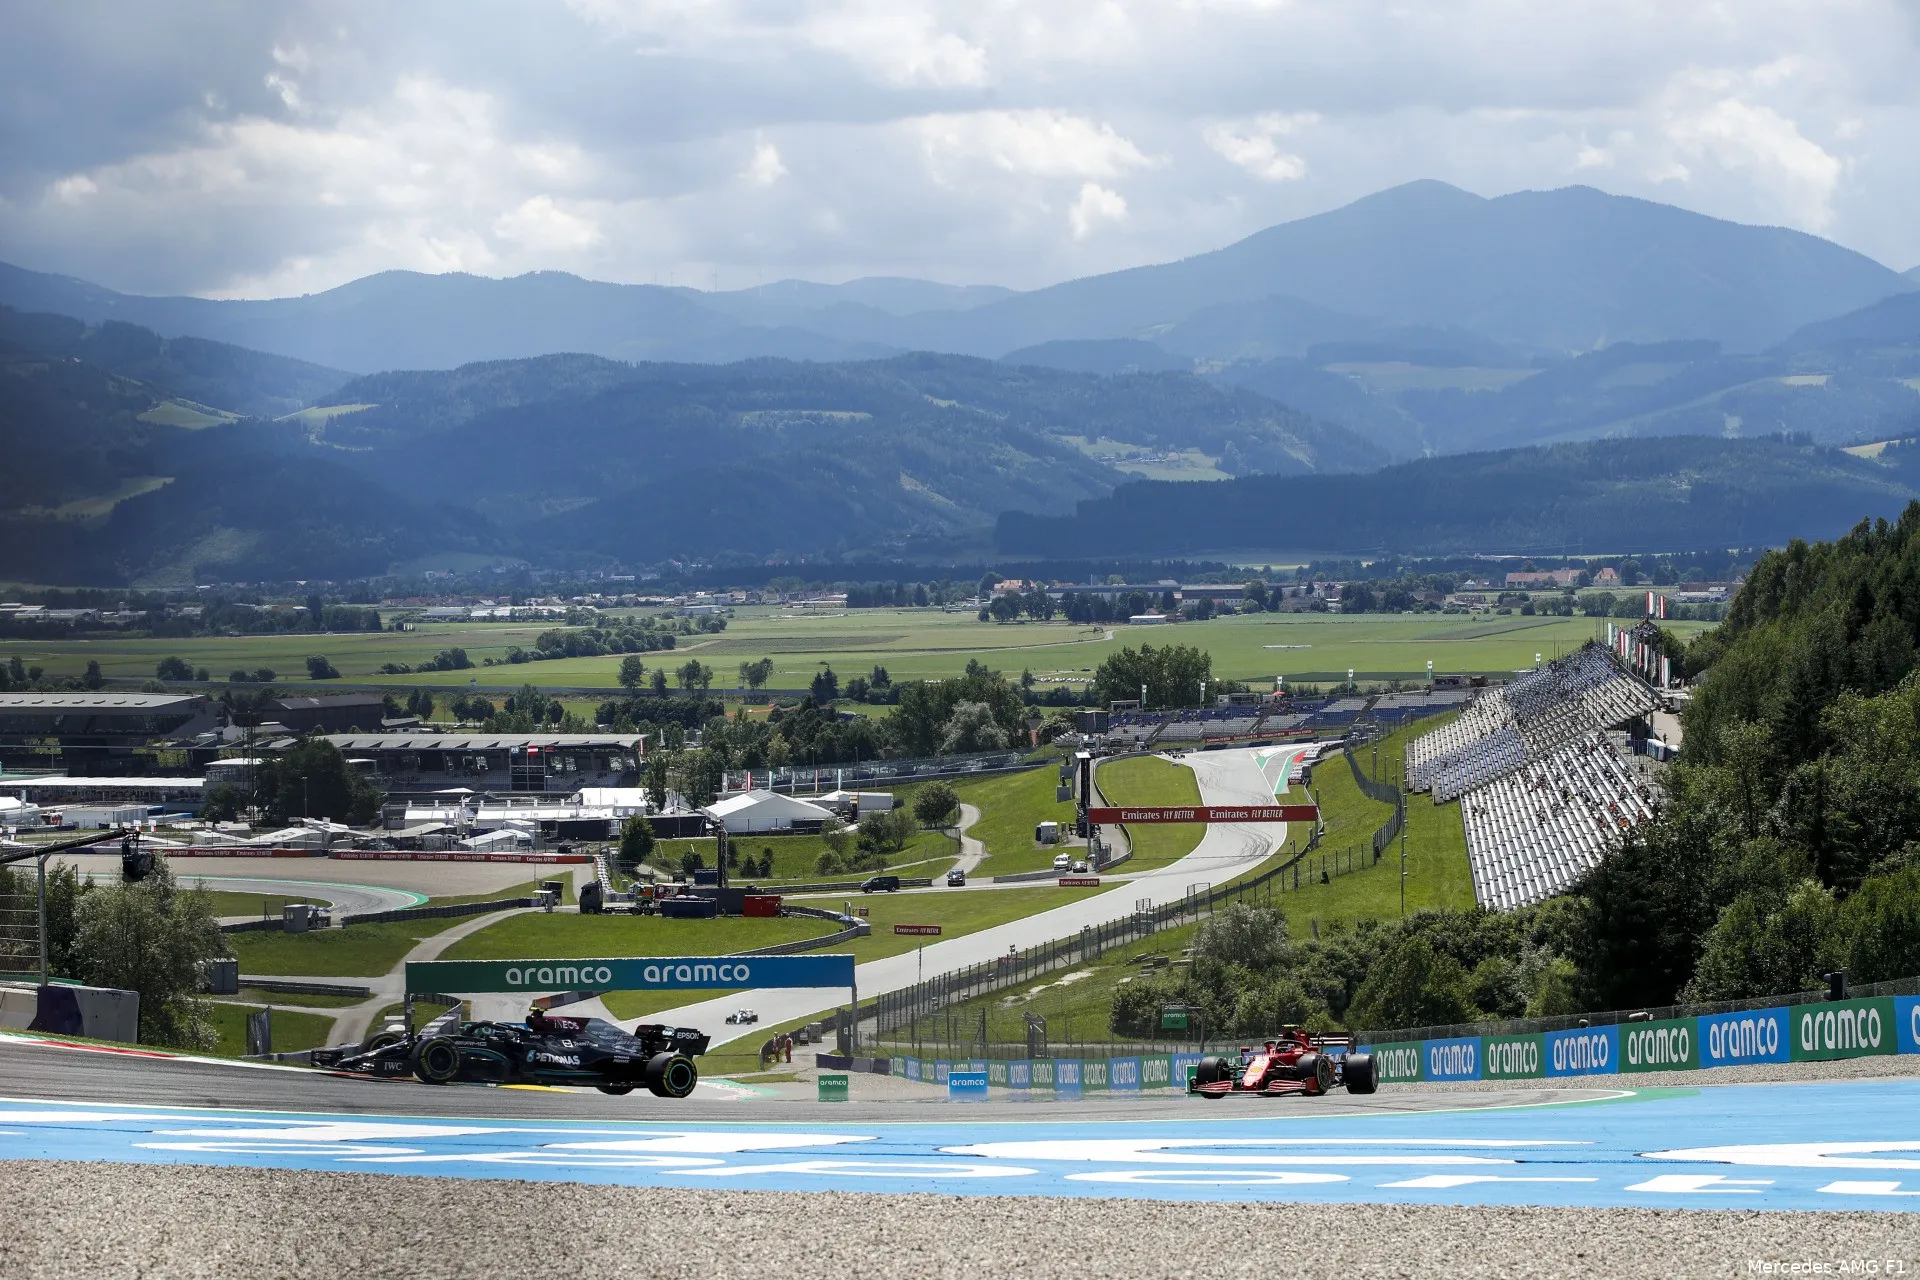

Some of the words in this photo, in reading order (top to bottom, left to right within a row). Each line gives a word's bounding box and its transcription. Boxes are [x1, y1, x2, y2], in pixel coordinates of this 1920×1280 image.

[1121, 811, 1160, 820] Emirates
[1163, 811, 1173, 819] FLY
[1174, 810, 1195, 819] BETTER
[1210, 810, 1248, 819] Emirates
[1251, 809, 1262, 818] FLY
[1263, 809, 1283, 818] BETTER
[505, 965, 612, 984] aramco
[643, 963, 751, 982] aramco
[677, 1032, 700, 1040] EPSON
[1709, 1017, 1779, 1059] aramco
[1801, 1007, 1882, 1051] aramco
[1553, 1033, 1609, 1071] aramco
[1628, 1027, 1690, 1064] aramco
[384, 1061, 403, 1071] IWC
[536, 1052, 581, 1065] PETRONAS
[1377, 1048, 1418, 1078] aramco
[1430, 1044, 1474, 1075] aramco
[1489, 1041, 1538, 1074] aramco
[951, 1078, 985, 1086] aramco
[1142, 1060, 1169, 1083] aramco
